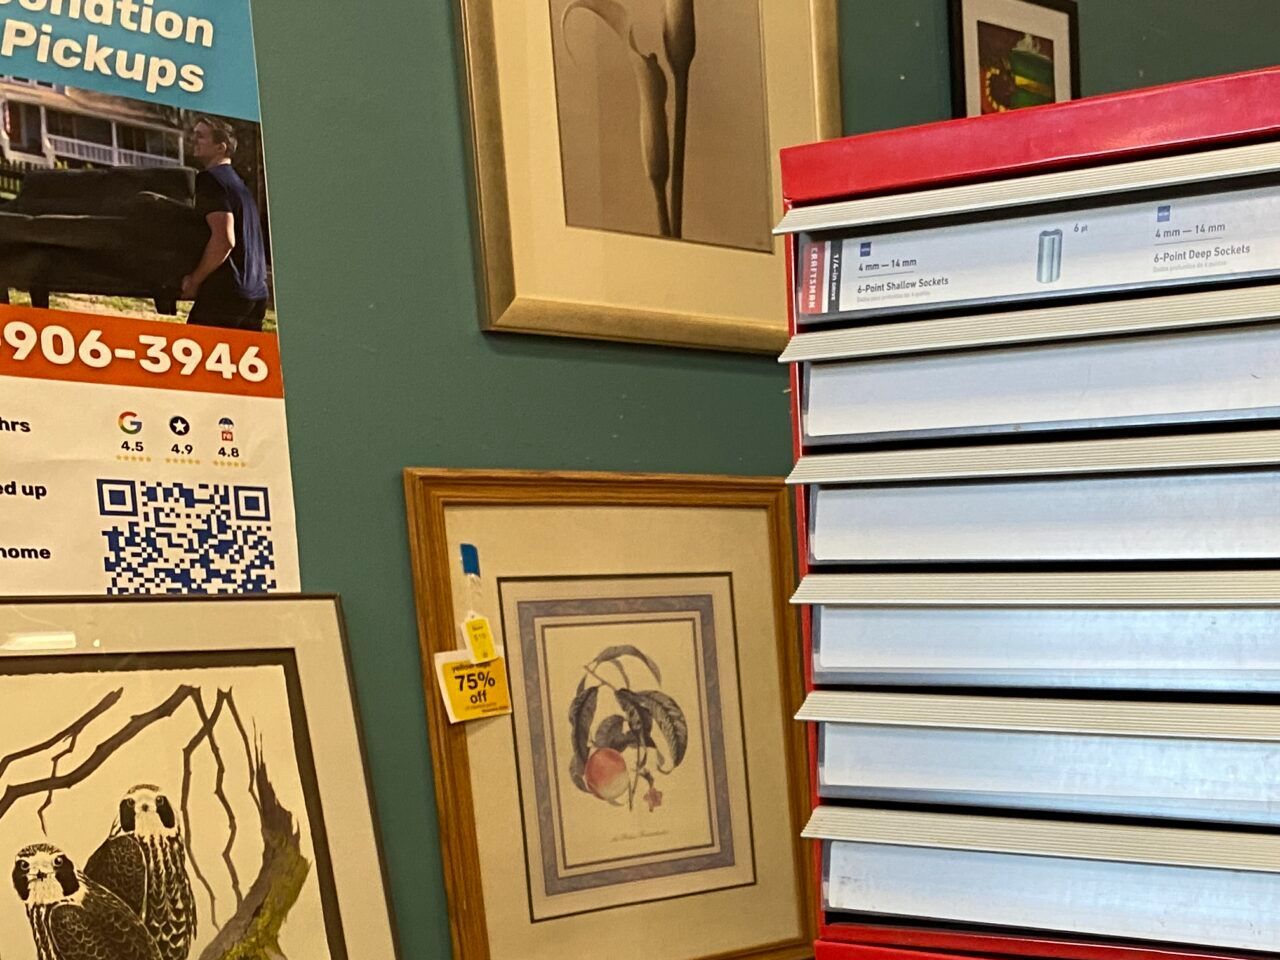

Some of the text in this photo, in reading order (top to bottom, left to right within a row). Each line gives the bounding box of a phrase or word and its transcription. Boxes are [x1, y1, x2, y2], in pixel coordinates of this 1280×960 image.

[0, 0, 214, 47] nation
[1, 18, 205, 94] Pickups
[1073, 223, 1079, 232] 6
[1155, 228, 1161, 238] 4
[1163, 229, 1180, 238] mm
[1195, 224, 1206, 234] 14
[1208, 223, 1225, 233] mm
[1153, 244, 1250, 263] 6-Point Deep Sockets
[858, 263, 863, 271] 4
[865, 263, 880, 271] mm
[891, 259, 900, 268] 14
[902, 259, 917, 267] mm
[808, 247, 818, 309] CRAFTSMAN
[857, 277, 949, 294] 6-Point Shallow Sockets
[121, 440, 144, 452] 4.5
[171, 443, 193, 455] 4.9
[217, 446, 240, 458] 4.8
[22, 484, 47, 500] up
[454, 671, 496, 692] 75%
[470, 690, 487, 704] off
